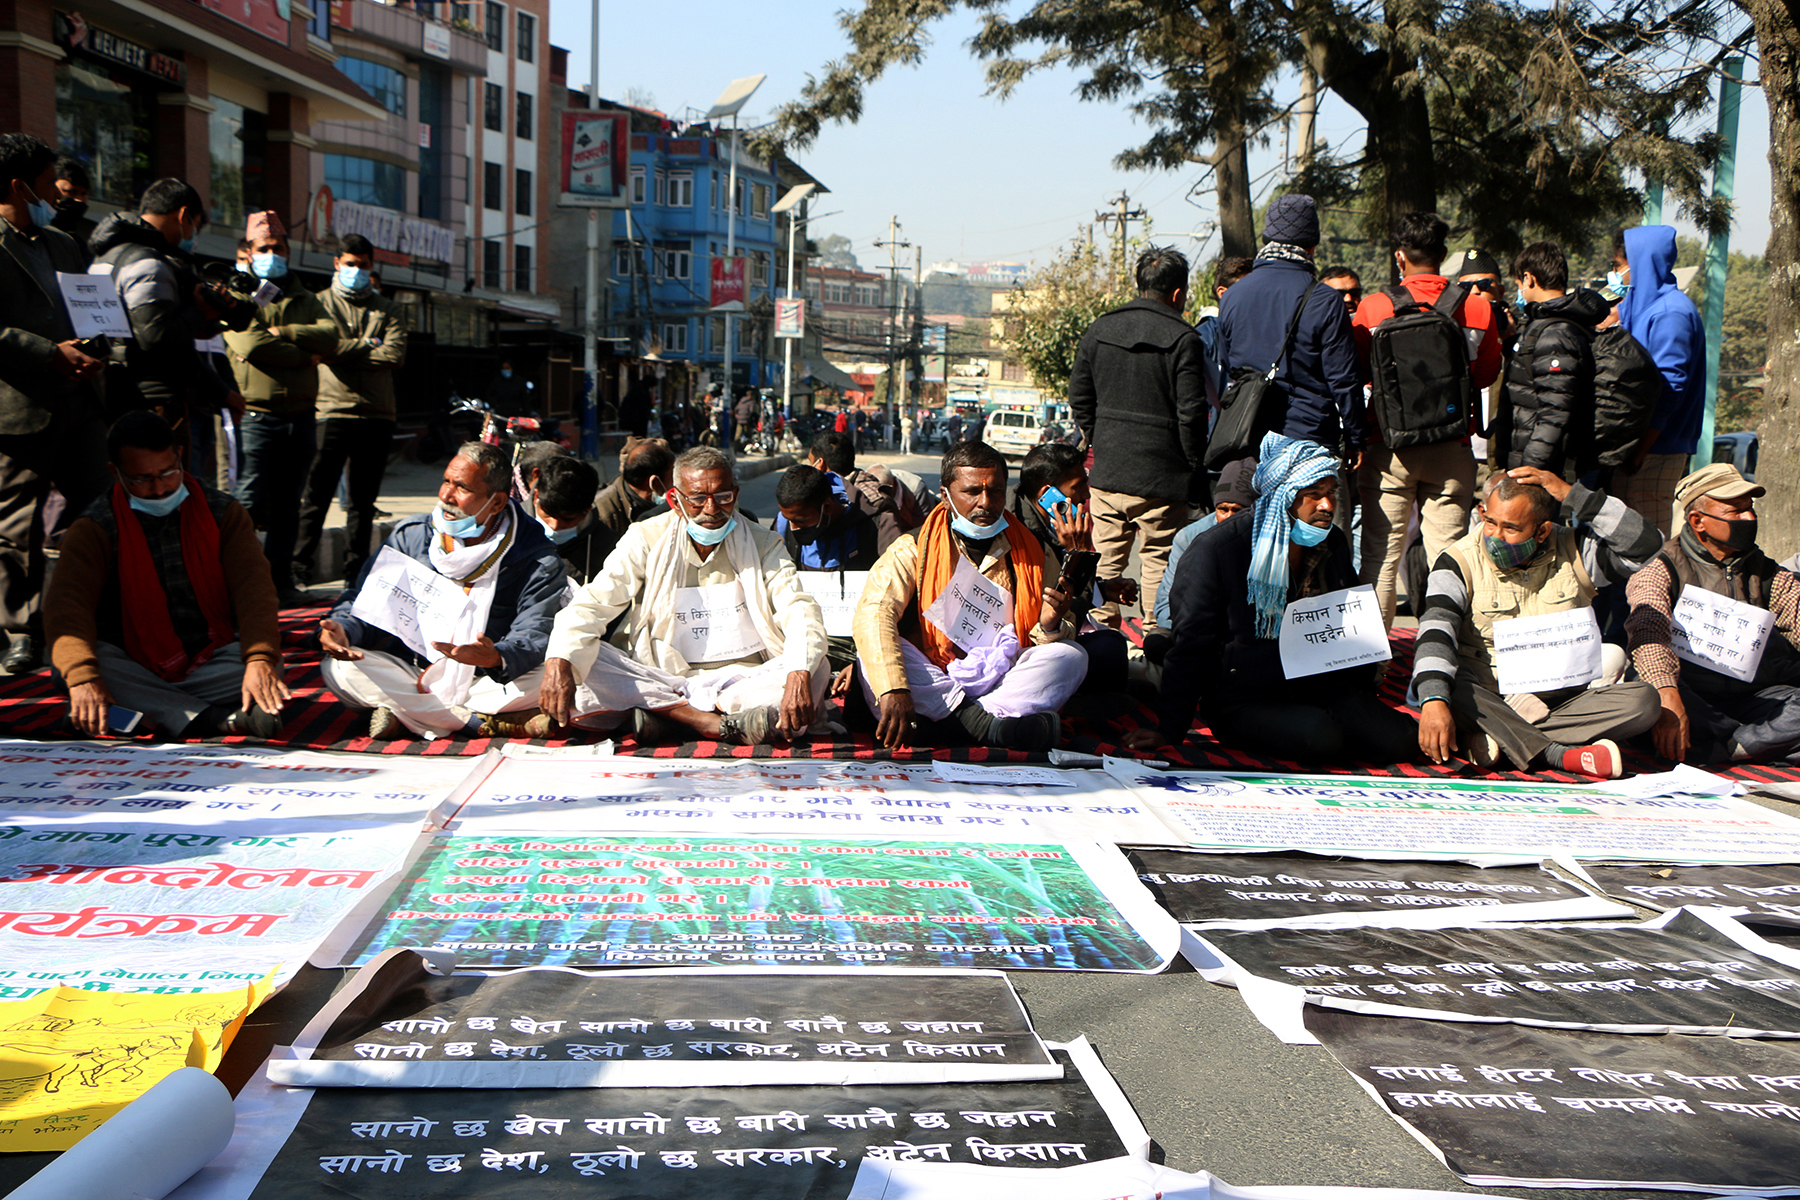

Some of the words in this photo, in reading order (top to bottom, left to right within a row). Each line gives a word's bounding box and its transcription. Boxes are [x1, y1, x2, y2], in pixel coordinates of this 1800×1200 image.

[93, 29, 147, 70] HELMETS
[149, 52, 183, 82] NEPAL
[972, 583, 1005, 612] सरकार
[1291, 606, 1331, 626] किसान
[691, 626, 709, 641] पुरा
[76, 780, 136, 791] गते
[142, 781, 236, 794] नेपाल
[246, 785, 363, 799] सरकार
[371, 791, 433, 801] संग
[206, 800, 261, 811] गर
[595, 794, 665, 804] साल
[806, 795, 857, 806] गते
[964, 801, 1073, 814] सरकार
[1084, 805, 1140, 815] संग
[877, 813, 944, 825] लागु
[956, 816, 1005, 826] गर
[30, 830, 137, 845] माग
[141, 833, 228, 848] पुरा
[230, 835, 311, 849] गर
[806, 845, 878, 855] रकम
[453, 857, 534, 868] सहित
[744, 860, 791, 869] गर
[0, 862, 384, 890] आन्दोलन
[441, 874, 534, 886] उखुमा
[657, 874, 777, 886] सरकारी
[780, 877, 891, 888] अनुदान
[896, 879, 973, 889] रकम
[1164, 872, 1274, 887] किसानले
[1275, 873, 1326, 888] पैसा
[654, 893, 706, 904] गर
[1224, 888, 1318, 903] सरकार
[580, 912, 723, 922] आन्दोलन
[669, 932, 806, 943] आयोजक
[604, 949, 713, 962] किसान
[719, 951, 827, 962] जनमत
[1279, 962, 1350, 978] सानो
[1348, 964, 1386, 976] छ
[1383, 962, 1436, 976] खेत
[1435, 961, 1504, 976] सानो
[1367, 983, 1407, 995] छ
[382, 1014, 457, 1035] सानो
[466, 1015, 499, 1033] छ
[510, 1014, 568, 1036] खेत
[579, 1016, 654, 1035] सानो
[664, 1018, 697, 1033] छ
[708, 1016, 772, 1034] बारी
[857, 1020, 892, 1036] छ
[899, 1020, 985, 1035] जहान
[353, 1041, 433, 1060] सानो
[443, 1041, 479, 1058] छ
[489, 1038, 550, 1060] देश,
[565, 1040, 631, 1060] ठूलो
[641, 1043, 675, 1059] छ
[688, 1040, 801, 1059] सरकार,
[816, 1039, 891, 1058] अटेन
[902, 1039, 1006, 1058] किसान
[1473, 1064, 1564, 1085] हीटर
[1568, 1067, 1665, 1089] तापेर
[1662, 1069, 1750, 1092] पैसा
[1387, 1089, 1547, 1114] हामीलाई
[350, 1116, 441, 1139] सानो
[451, 1119, 491, 1138] छ
[503, 1114, 571, 1137] खेत
[583, 1111, 673, 1136] सानो
[684, 1115, 722, 1136] छ
[735, 1110, 810, 1133] बारी
[909, 1111, 951, 1130] छ
[958, 1110, 1057, 1129] जहान
[318, 1148, 413, 1174] सानो
[425, 1152, 467, 1174] छ
[479, 1147, 551, 1175] देश,
[569, 1145, 647, 1177] ठूलो
[658, 1149, 699, 1171] छ
[712, 1146, 848, 1169] सरकार,
[862, 1140, 953, 1163] अटेन
[965, 1135, 1088, 1162] किसान
